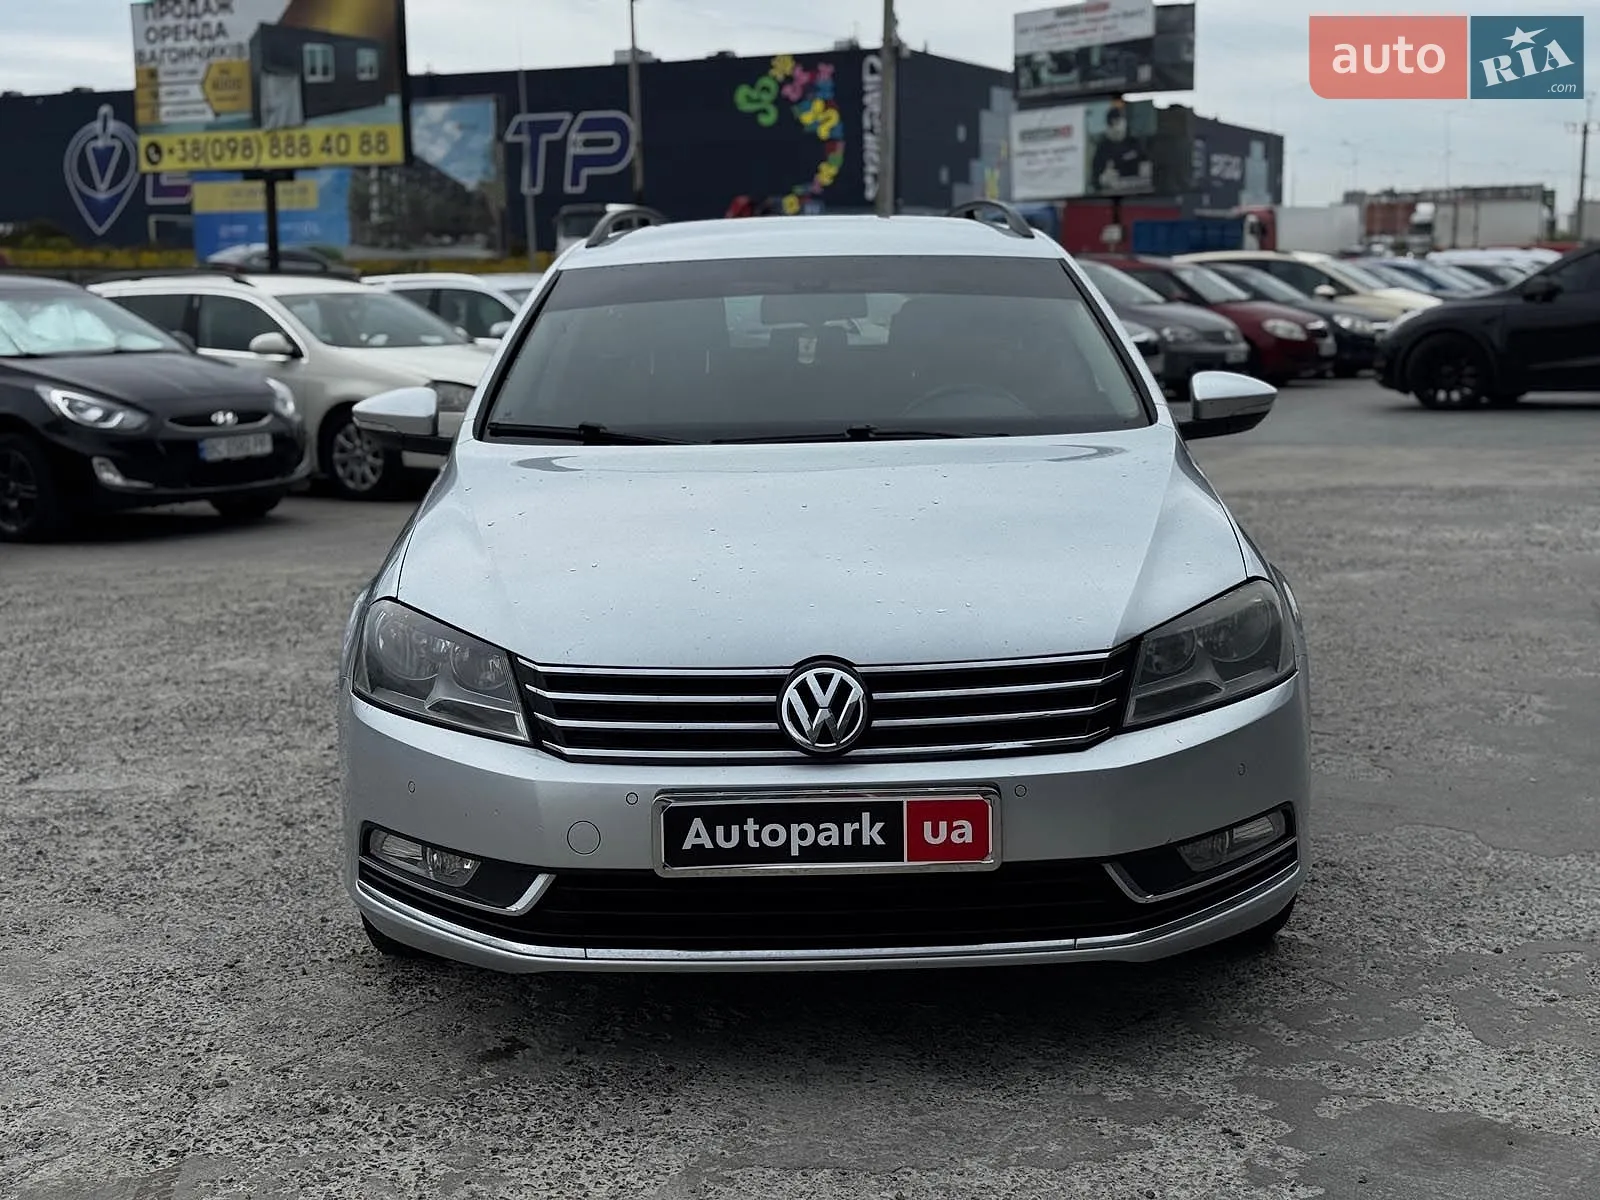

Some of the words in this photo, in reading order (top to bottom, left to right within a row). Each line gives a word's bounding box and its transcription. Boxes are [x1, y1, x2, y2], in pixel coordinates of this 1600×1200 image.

[144, 21, 230, 45] ОРЕНДА
[319, 131, 351, 157] 40
[359, 129, 389, 156] 88
[682, 812, 886, 856] Autopark
[923, 819, 973, 845] ua
